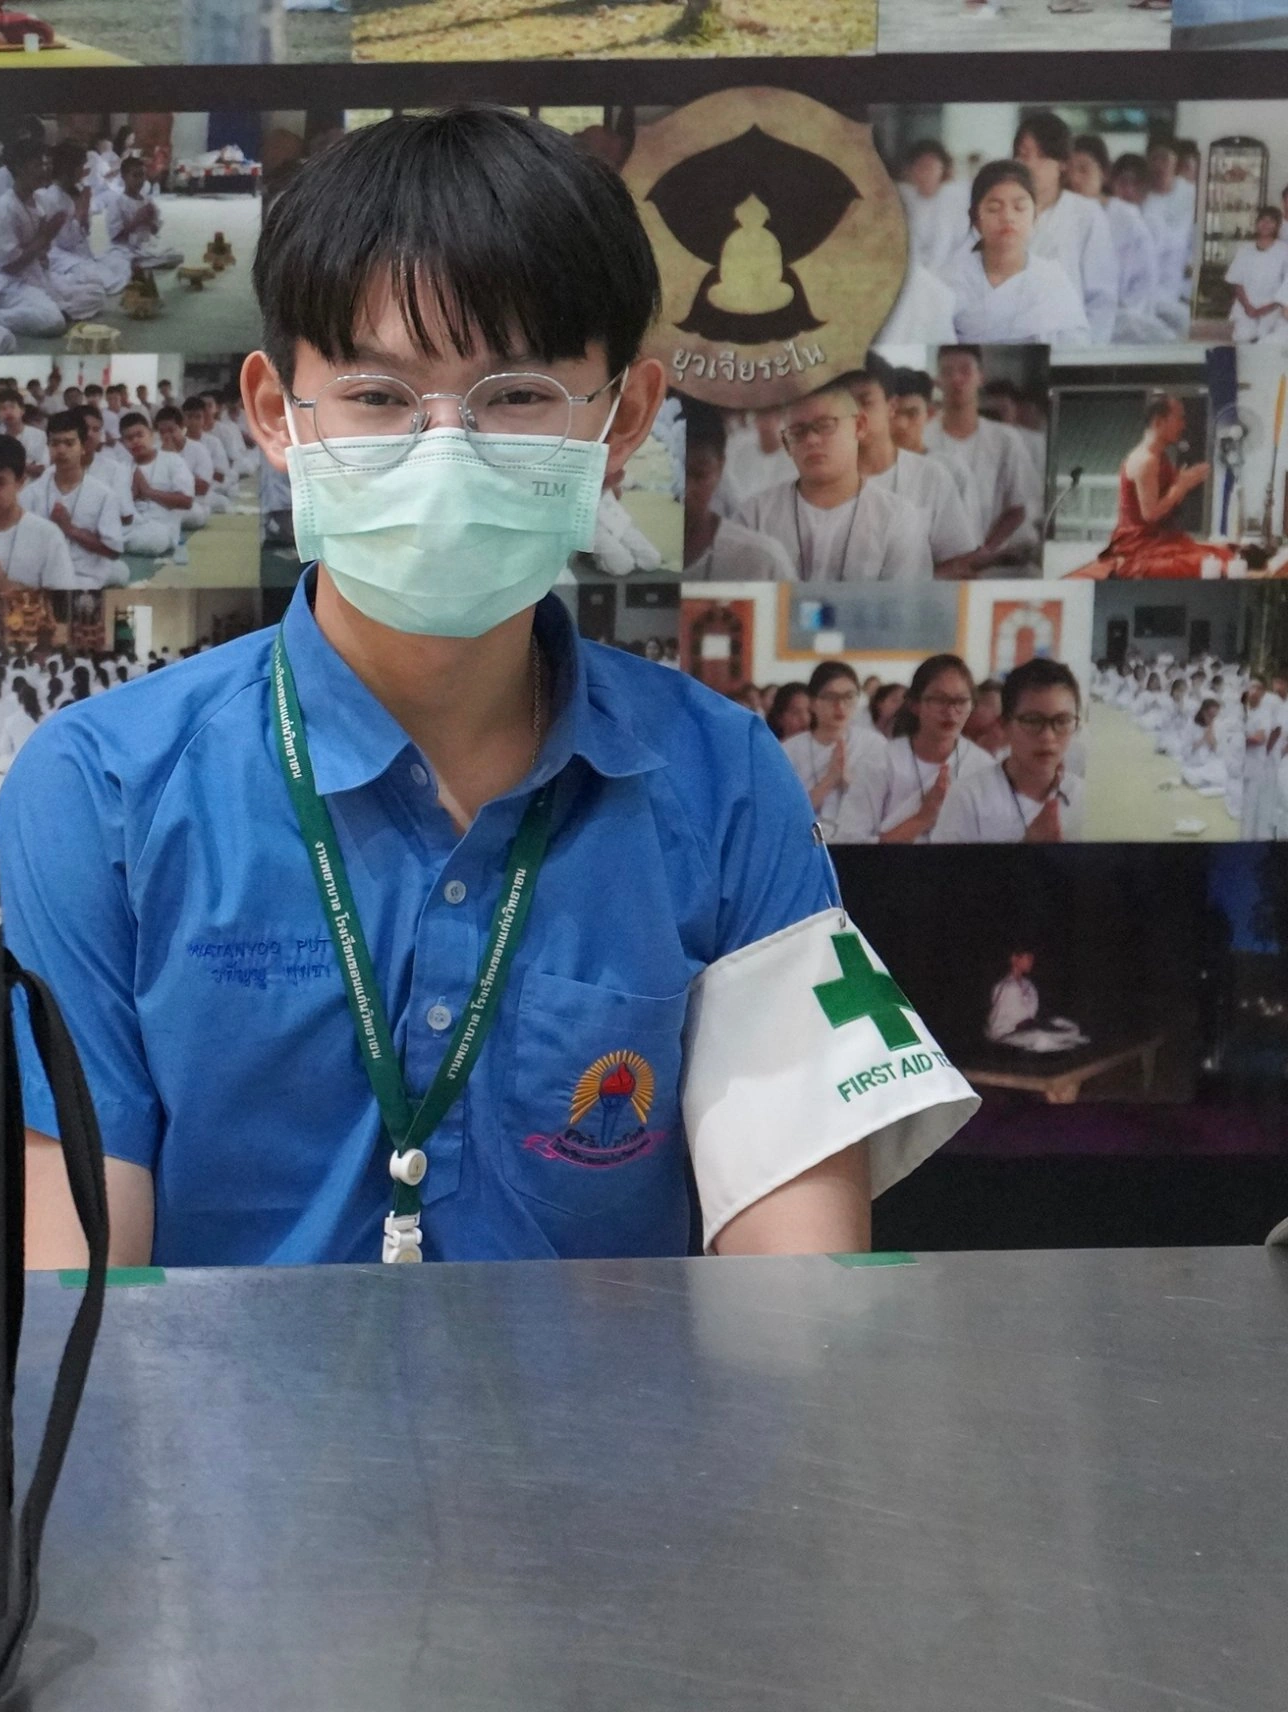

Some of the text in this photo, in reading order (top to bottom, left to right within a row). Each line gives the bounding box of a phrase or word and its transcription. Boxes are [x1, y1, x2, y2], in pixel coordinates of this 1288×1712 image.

[672, 341, 826, 383] ยุวเจียระไน
[532, 480, 567, 498] TLM
[314, 841, 383, 1059] งานพยาบาล โรงเรียนขอนแก่นวิทยายน
[447, 867, 527, 1080] งานพยาบาล โรงเรียนขอนแก่นวิทยายน
[837, 1062, 897, 1103] FIRST
[901, 1053, 934, 1079] AID
